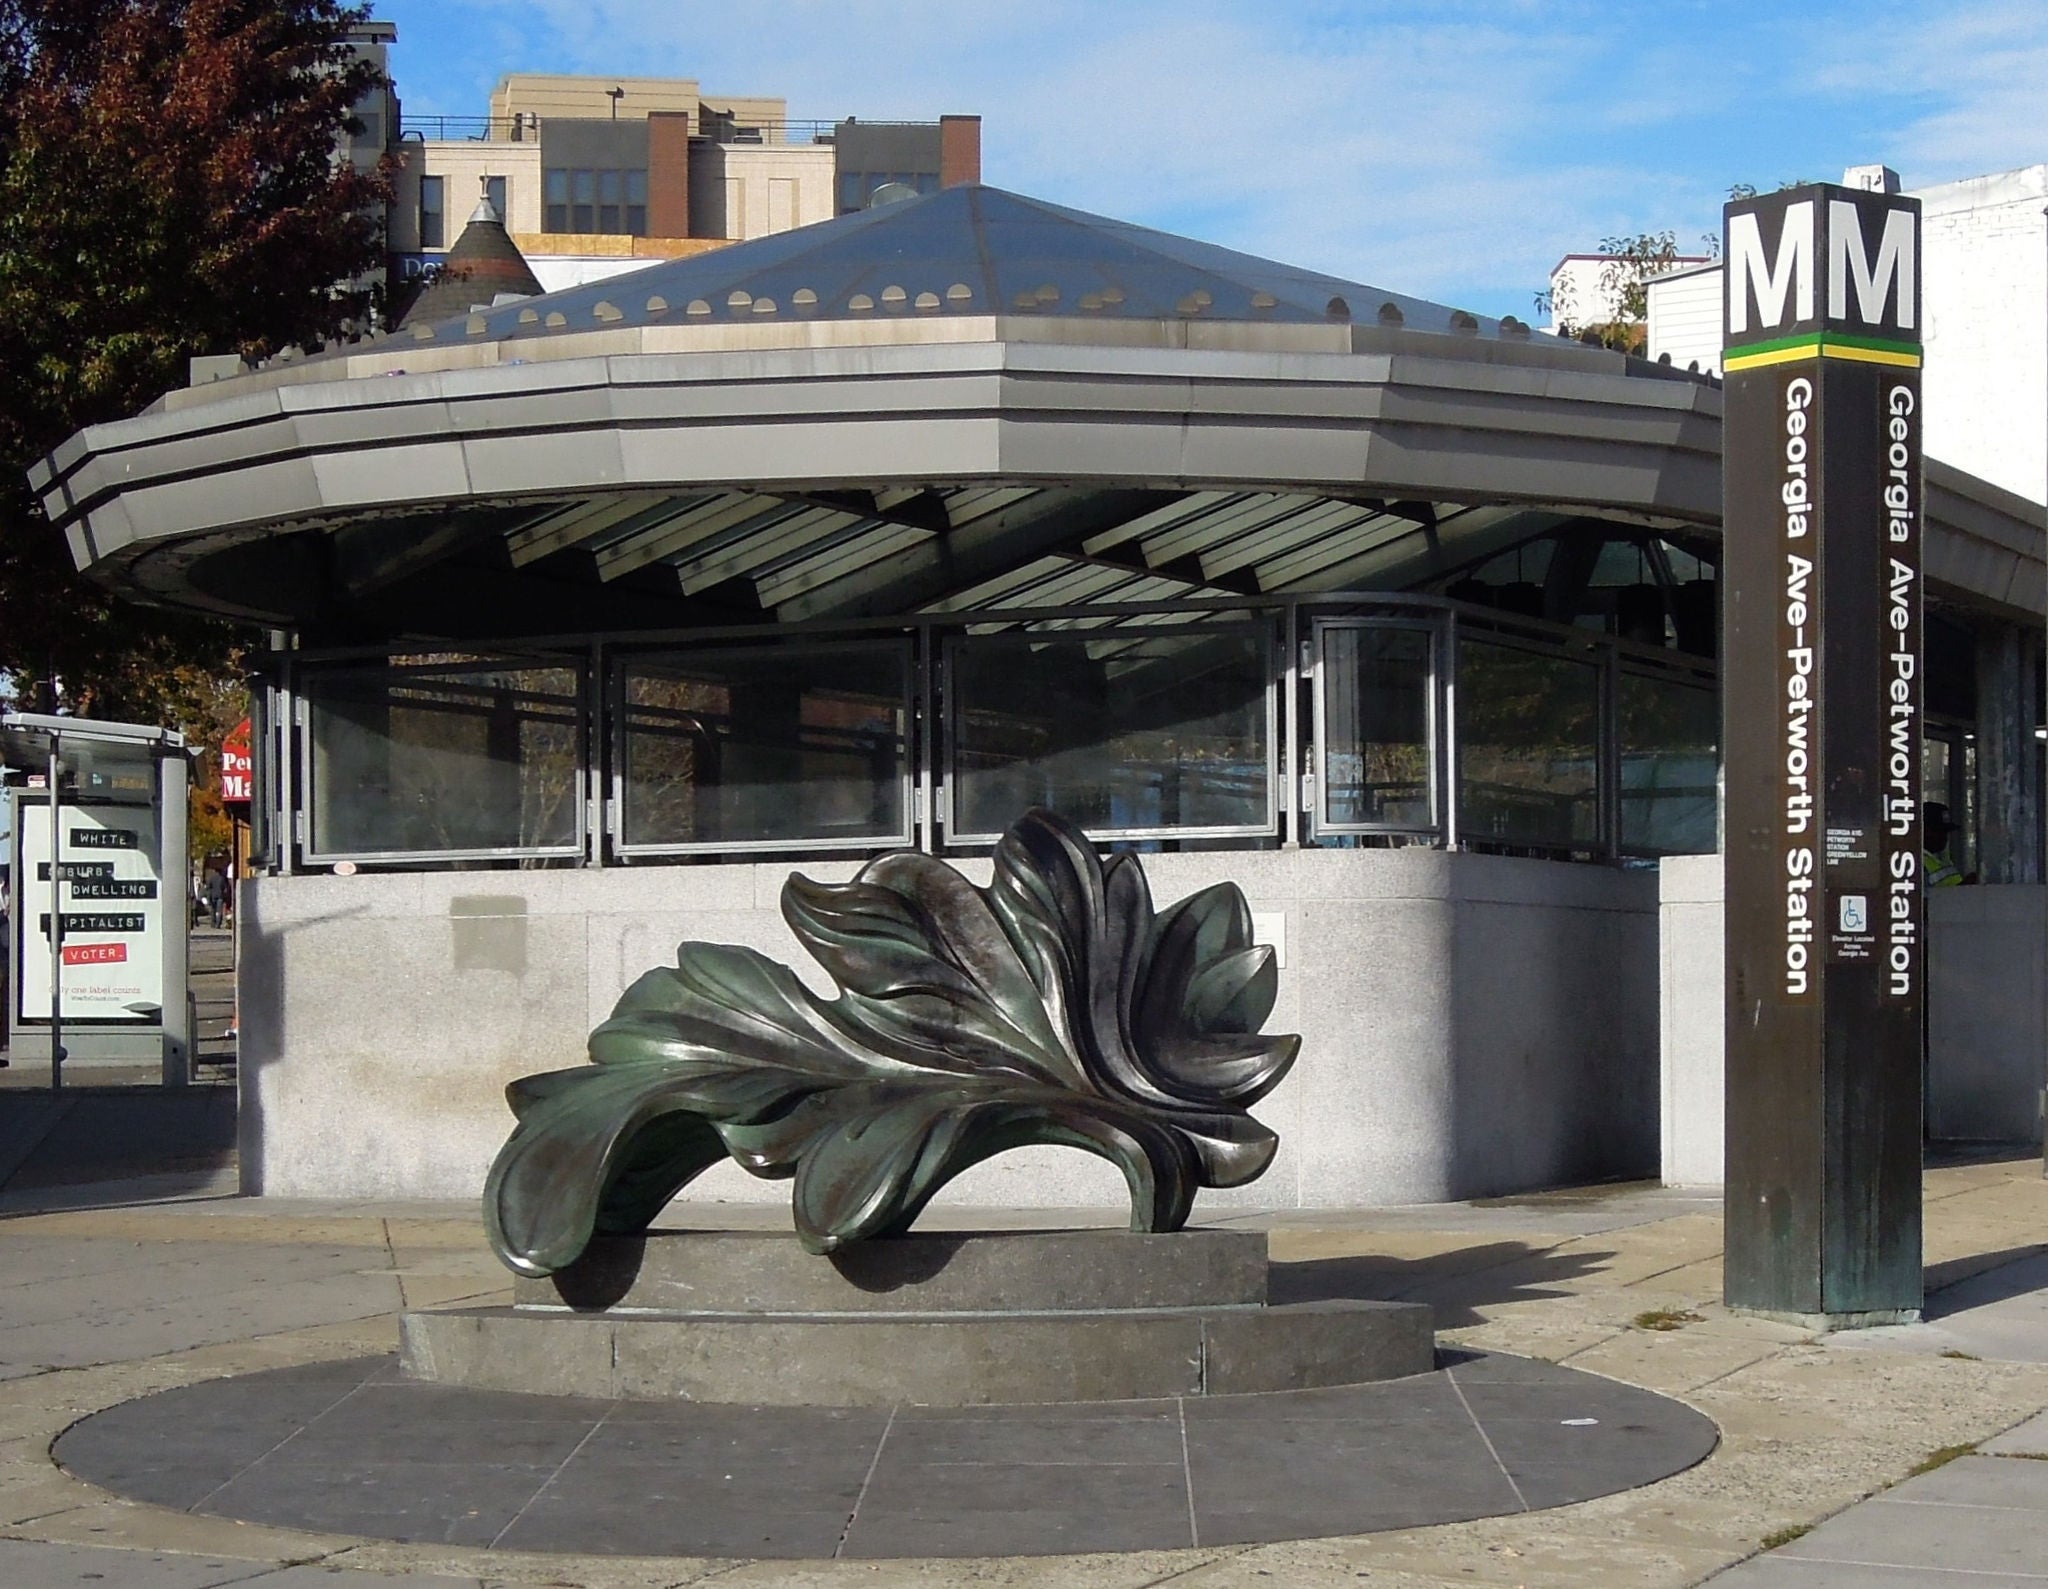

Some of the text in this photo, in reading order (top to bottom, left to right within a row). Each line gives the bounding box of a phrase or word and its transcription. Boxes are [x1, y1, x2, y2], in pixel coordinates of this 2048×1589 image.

[1729, 200, 1814, 334] M
[1829, 200, 1915, 329] M
[1782, 377, 1813, 539] Georgia
[1884, 385, 1914, 543] Georgia
[48, 866, 113, 878] SBURB-
[72, 884, 147, 896] DWELLING
[79, 833, 128, 845] WHITE
[52, 917, 144, 929] PITALIST
[1787, 848, 1813, 995] Station
[1890, 851, 1915, 995] Station
[49, 985, 69, 995] Oly
[89, 985, 111, 994] label
